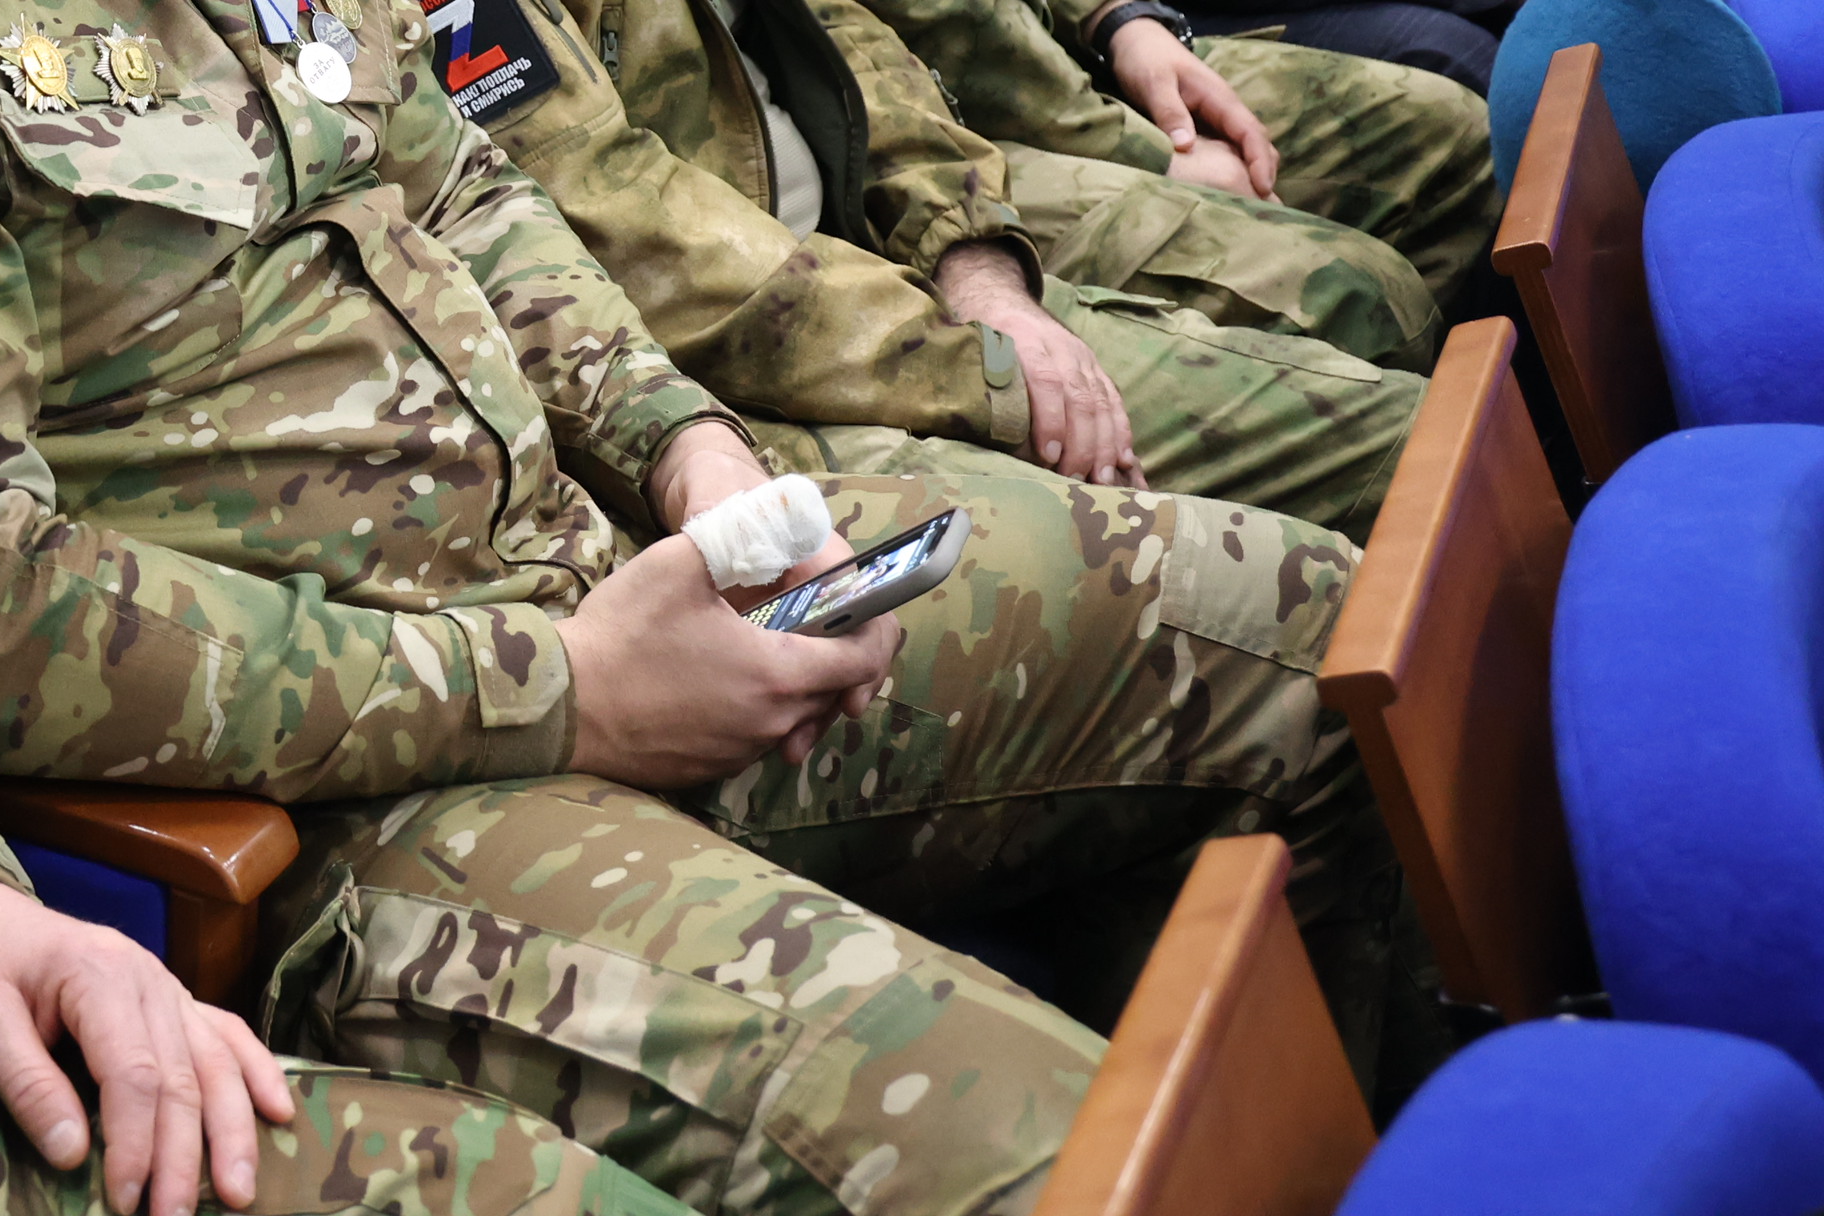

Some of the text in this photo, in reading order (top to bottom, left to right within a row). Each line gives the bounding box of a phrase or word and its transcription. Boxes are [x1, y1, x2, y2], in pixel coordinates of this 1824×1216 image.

[309, 55, 336, 84] ОТВАГУ
[313, 58, 325, 70] ЗА
[452, 56, 532, 108] КАК! ПОПЛАЧЬ
[460, 76, 526, 119] И СМИРИСЬ
